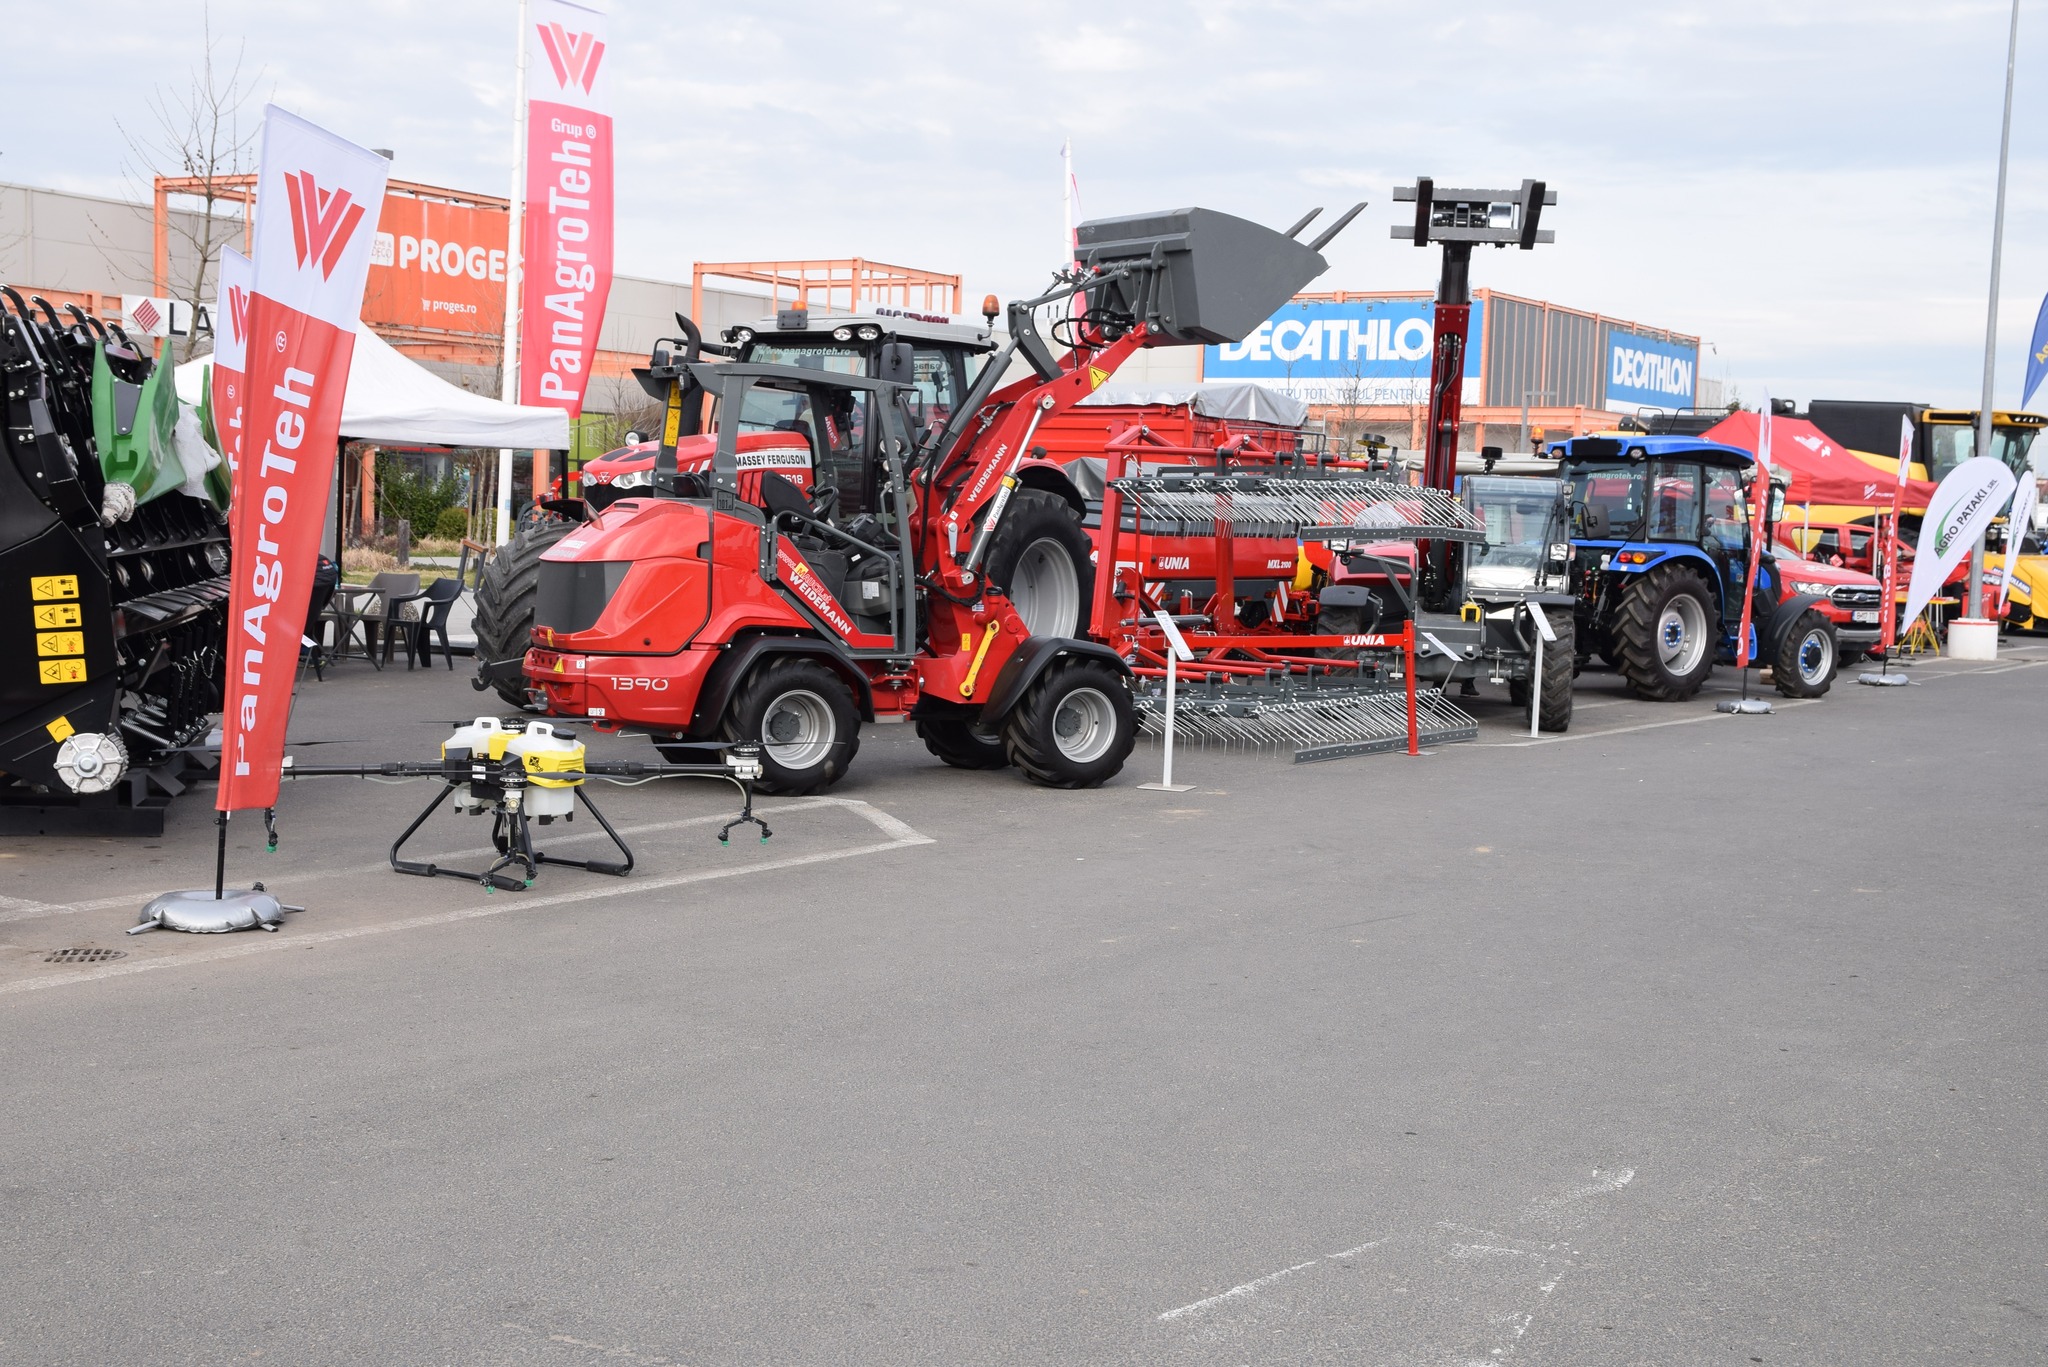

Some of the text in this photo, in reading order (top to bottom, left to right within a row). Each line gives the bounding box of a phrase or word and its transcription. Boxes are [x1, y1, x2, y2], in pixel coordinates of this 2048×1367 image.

[551, 118, 582, 138] Grup
[540, 141, 595, 401] PanAgroTeh
[433, 300, 477, 314] proges.ro
[1220, 318, 1435, 361] ECATHLO
[1612, 346, 1692, 397] DECATHLON
[736, 455, 806, 467] MASSEY FERGUSON
[967, 443, 1008, 502] WEIDEMANN
[1587, 469, 1642, 480] panagroteh.ro
[1934, 526, 1959, 554] AGRO
[1958, 488, 1988, 526] PATAKI
[235, 366, 316, 777] PanAgroTeh
[1164, 557, 1190, 570] UNIA
[789, 571, 852, 635] WEIDEMANN
[1351, 635, 1385, 645] UNIA
[611, 677, 669, 691] 1390
